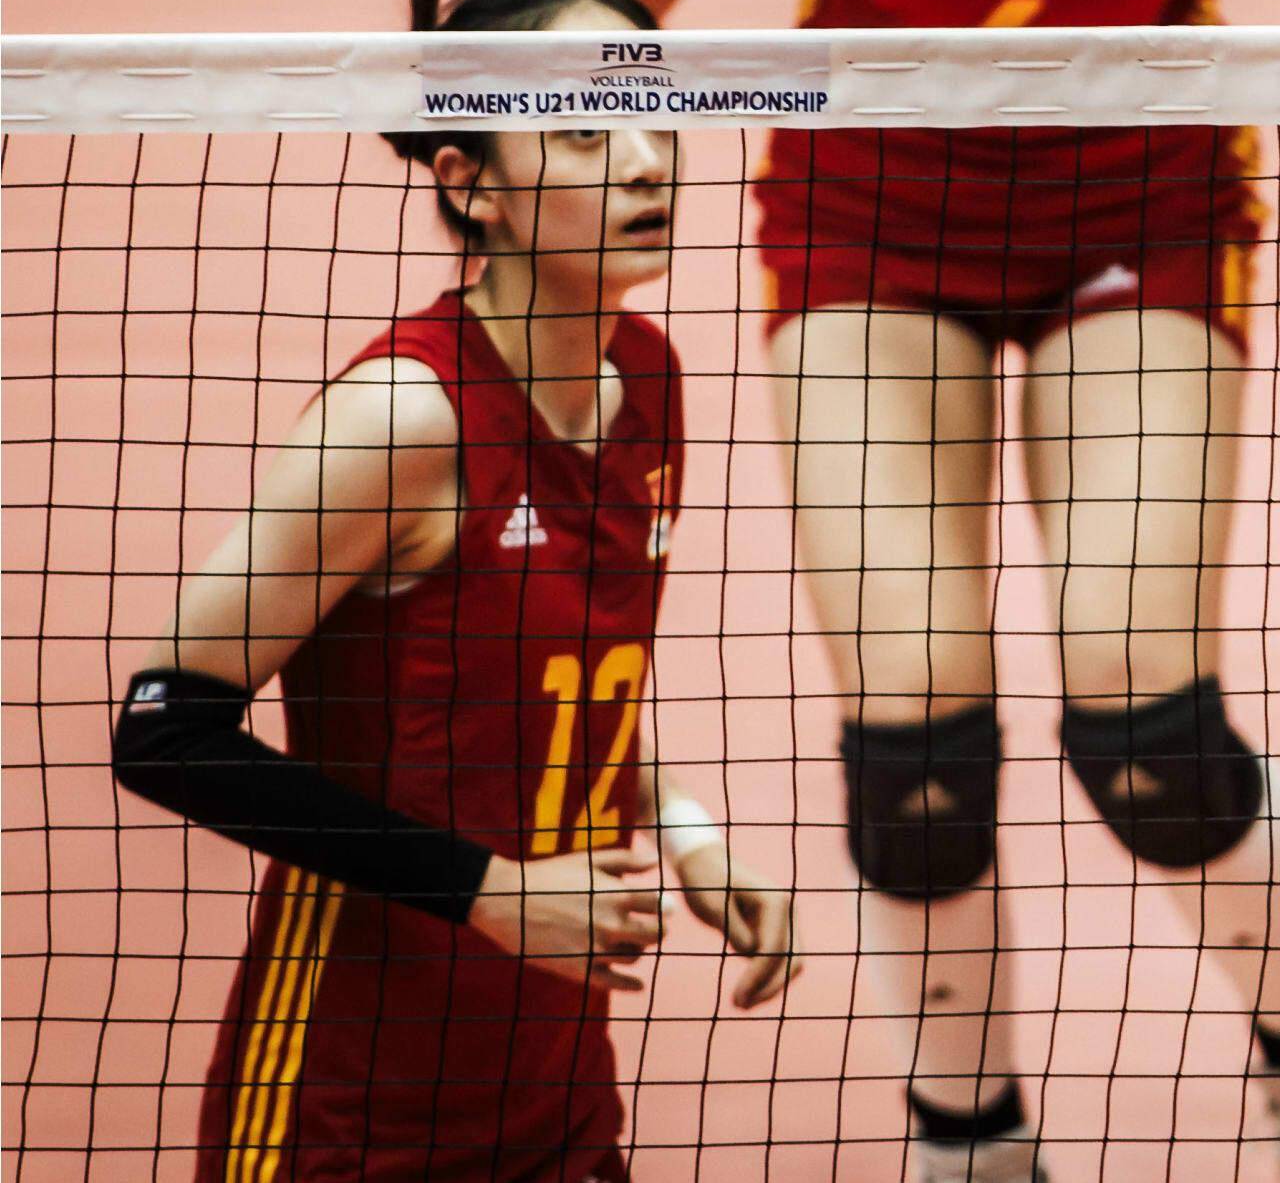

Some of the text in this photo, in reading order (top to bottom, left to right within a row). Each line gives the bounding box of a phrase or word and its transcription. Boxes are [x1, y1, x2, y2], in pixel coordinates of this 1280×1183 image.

[590, 75, 674, 88] VOLLEYBALL
[425, 91, 828, 114] WOMEN'S U21 WORLD CHAMPIONSHIP
[531, 643, 645, 855] 12
